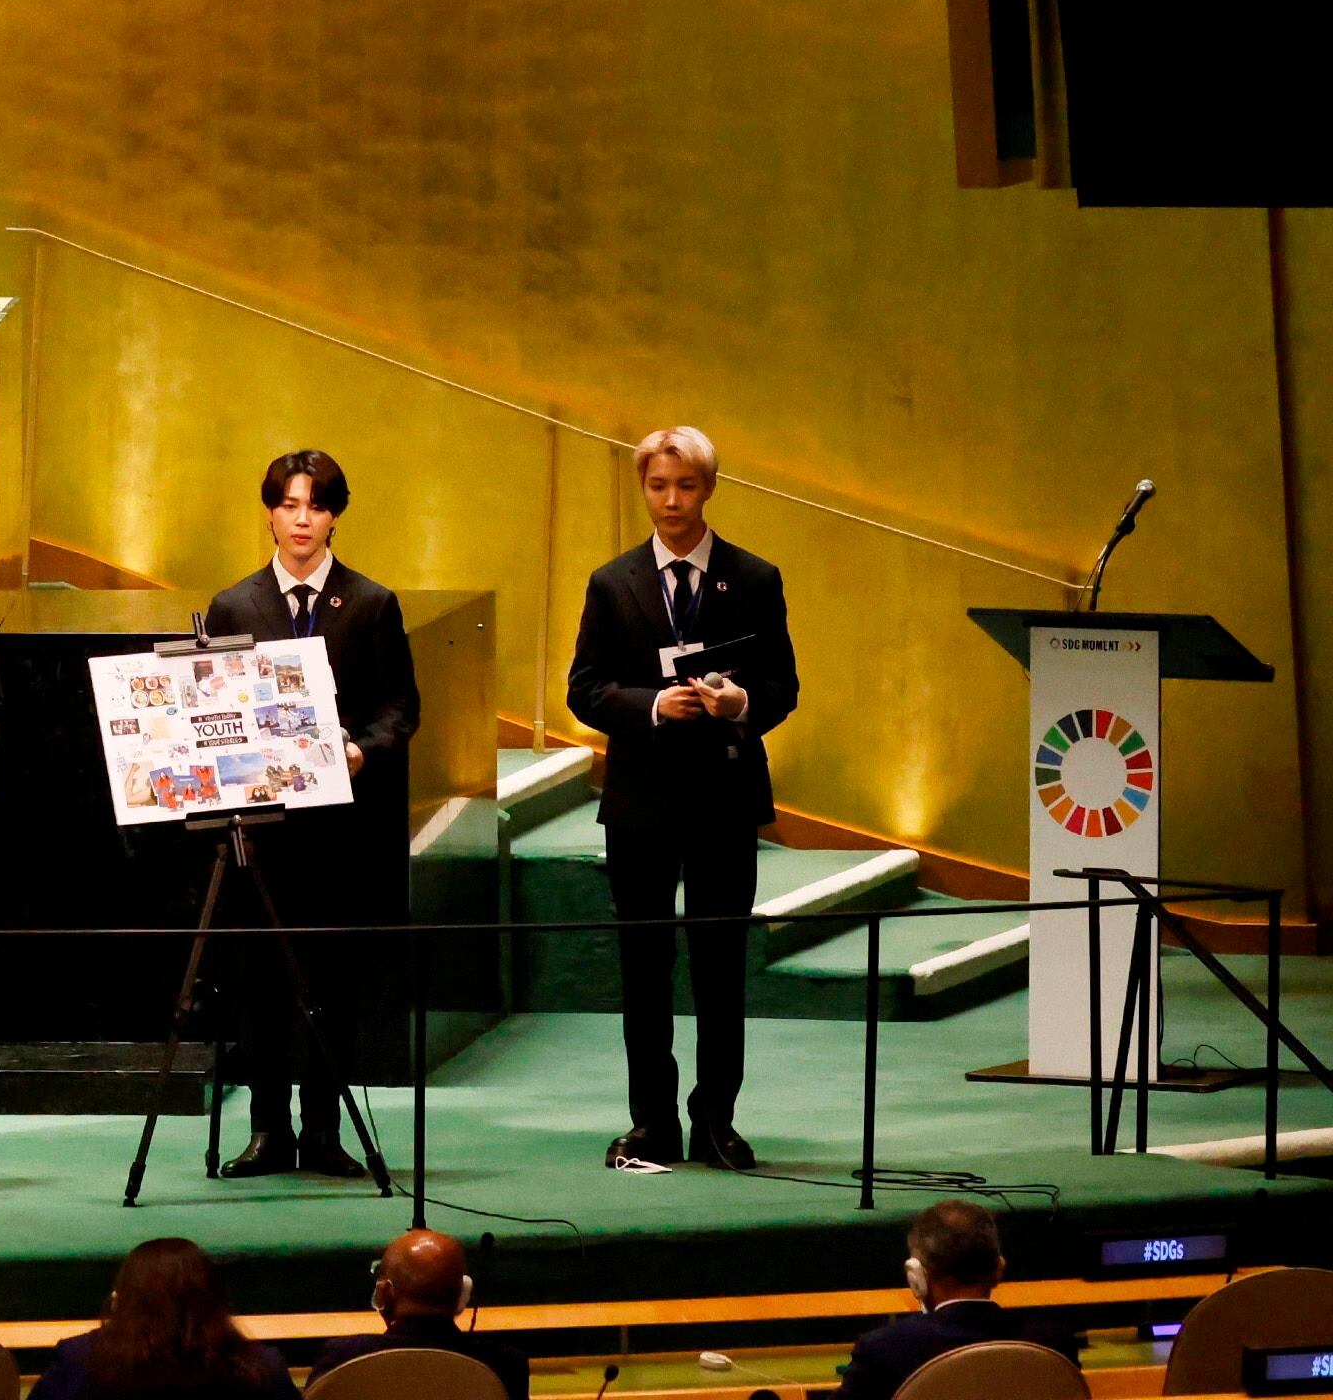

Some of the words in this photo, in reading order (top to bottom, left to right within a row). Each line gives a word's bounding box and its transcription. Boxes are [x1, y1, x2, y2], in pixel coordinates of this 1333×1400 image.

[1062, 638, 1081, 650] SDG
[1082, 639, 1120, 651] MOMENT
[193, 721, 244, 738] YOUTH
[1143, 1239, 1184, 1262] #SDGs
